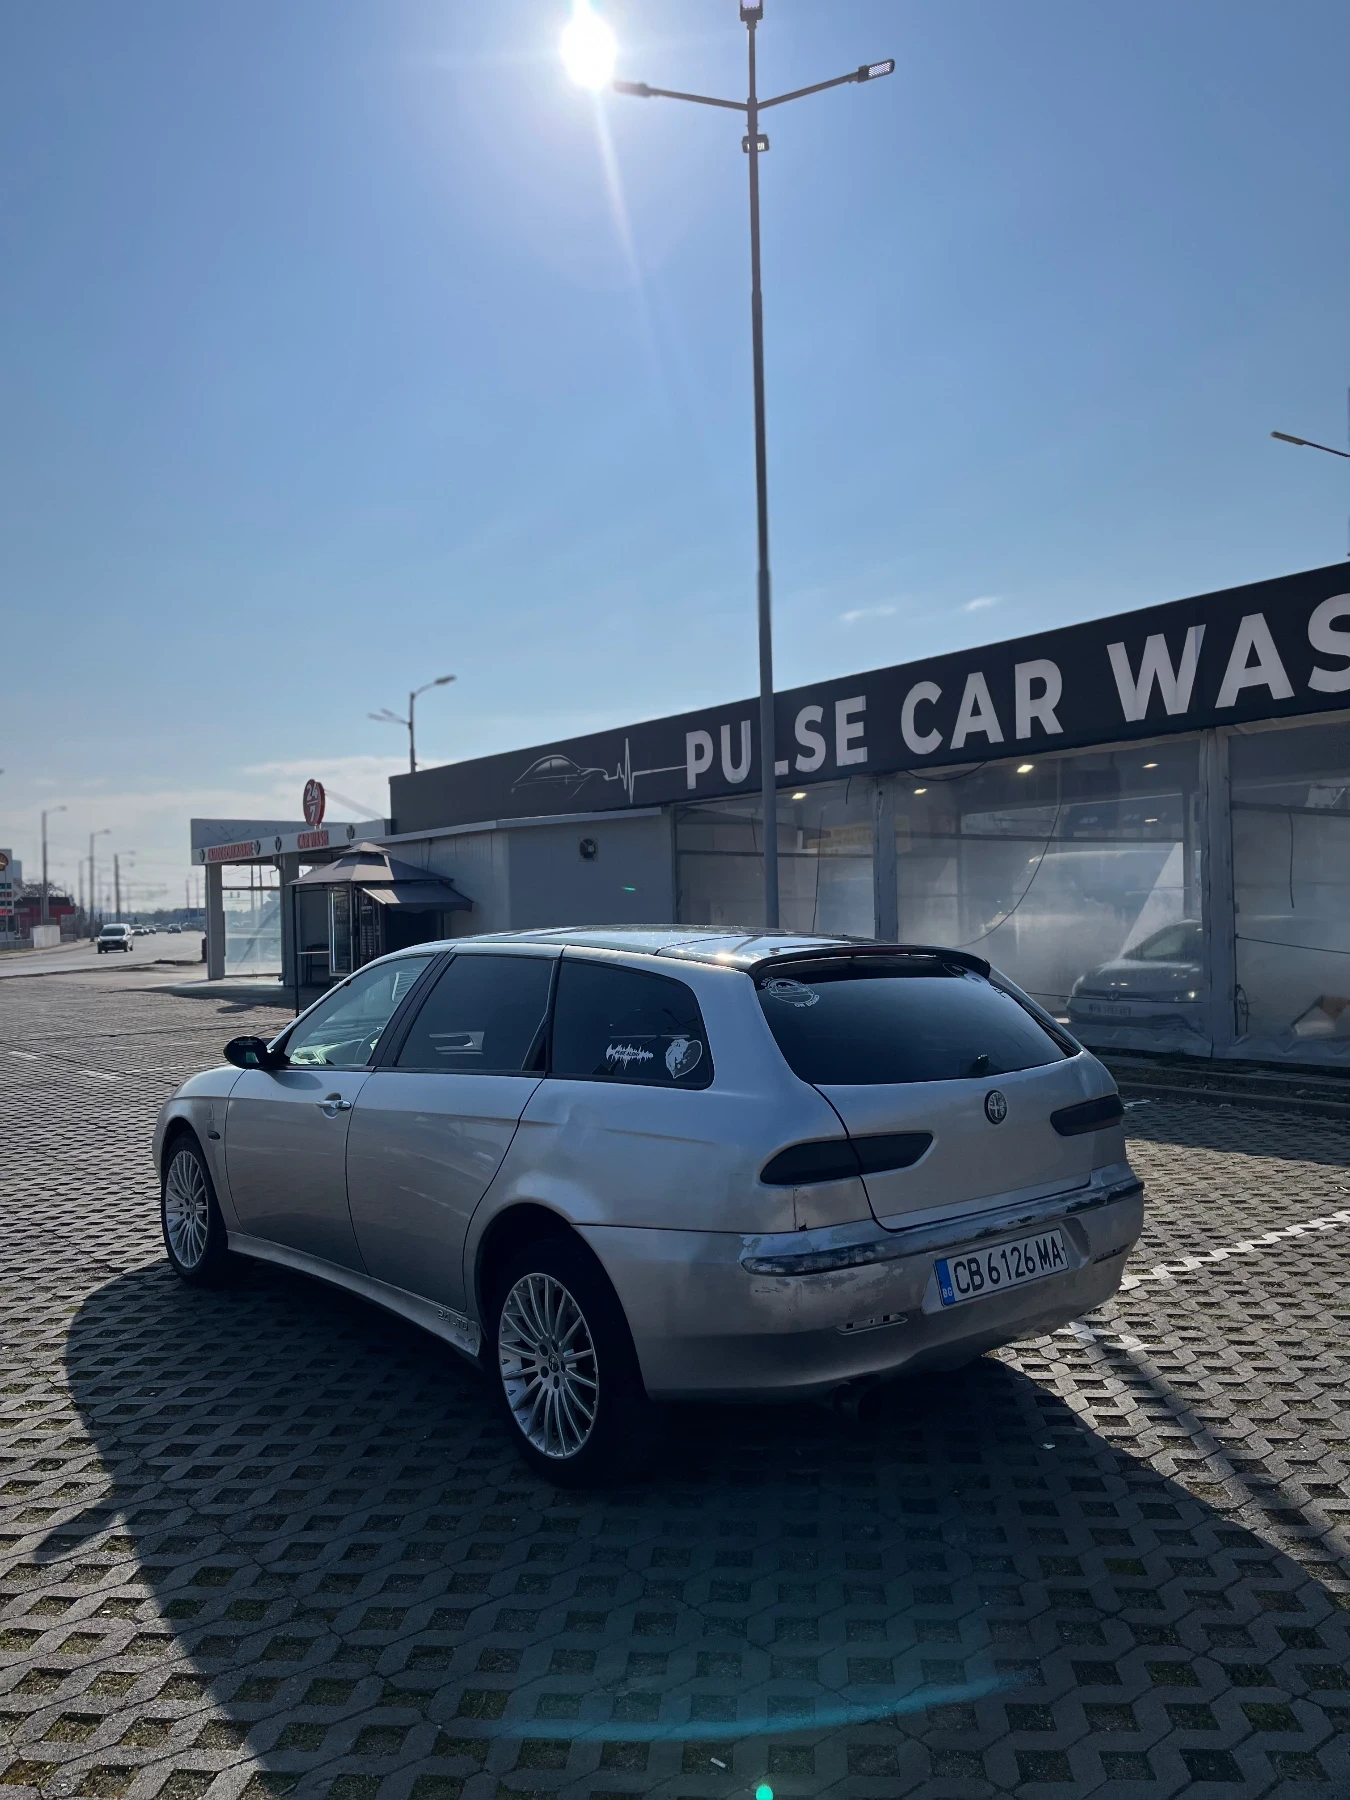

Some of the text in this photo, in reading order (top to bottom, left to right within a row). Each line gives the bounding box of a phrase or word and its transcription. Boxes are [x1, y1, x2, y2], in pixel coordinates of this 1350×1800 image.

[686, 593, 1350, 790] PUSE CAR WAS
[306, 783, 318, 801] 24
[309, 805, 316, 822] 7
[297, 830, 329, 850] CAR WASH
[953, 1236, 1064, 1293] CB 6126 MA
[942, 1287, 953, 1298] BG
